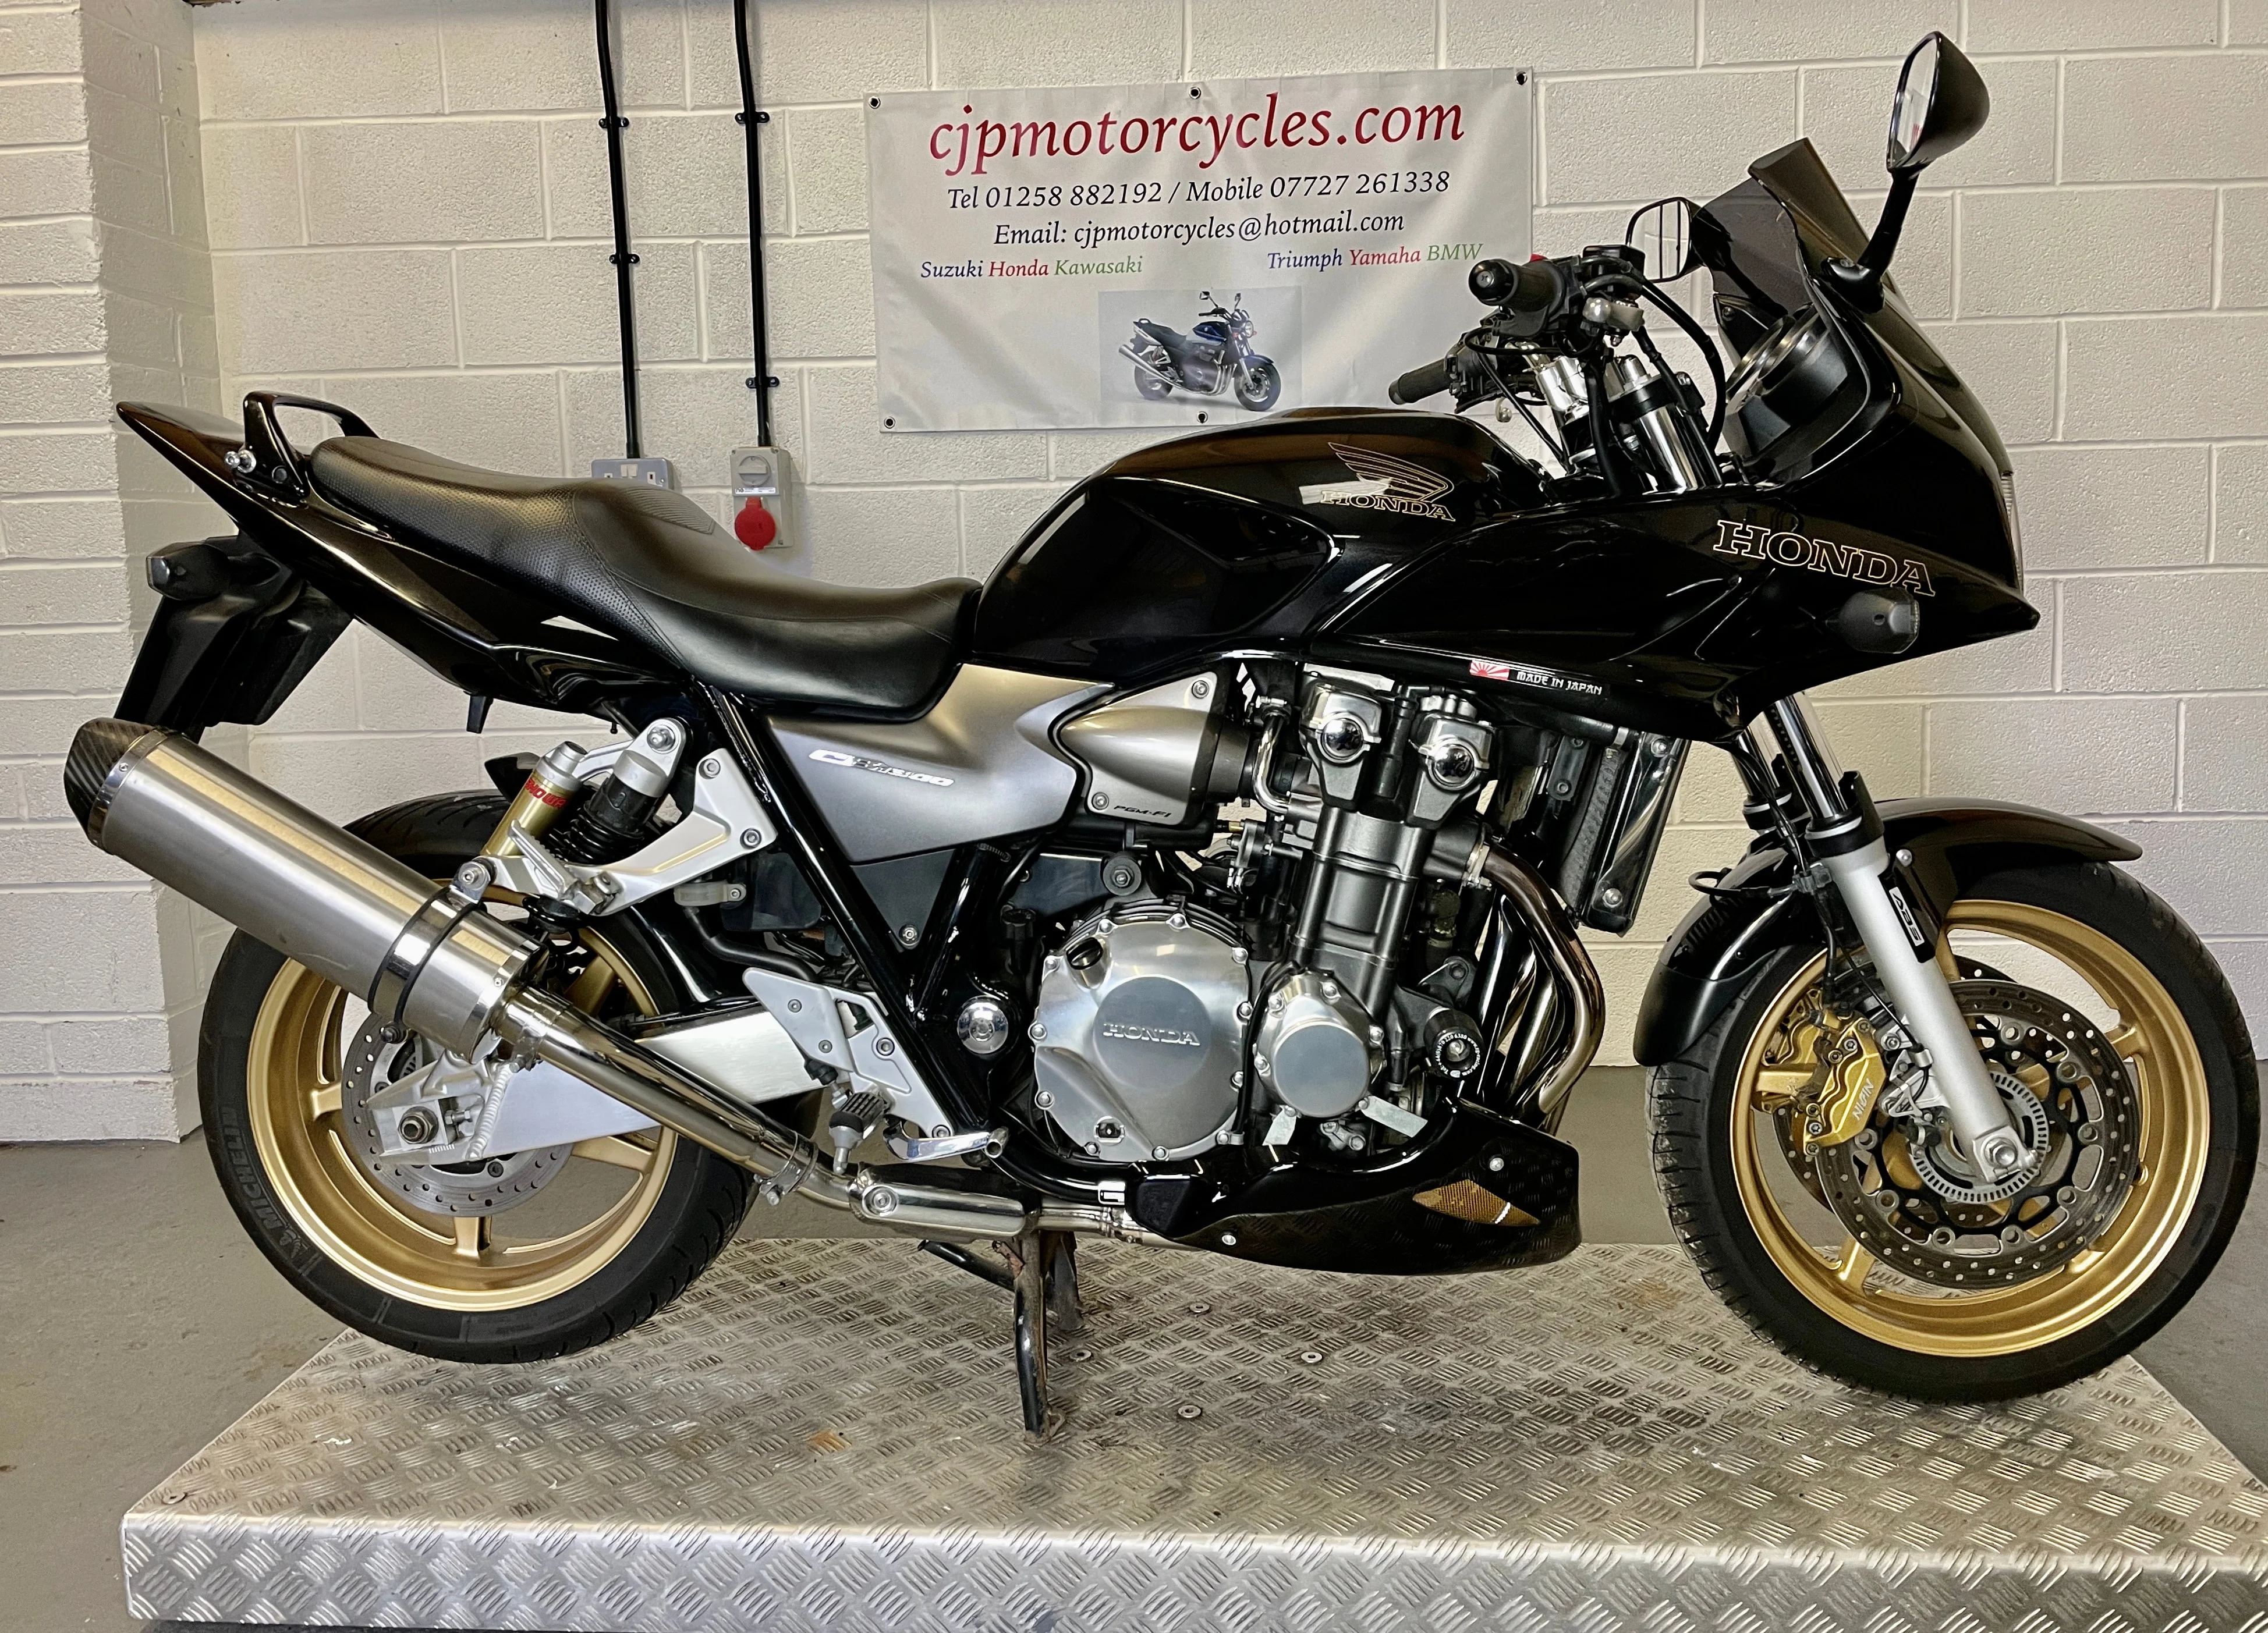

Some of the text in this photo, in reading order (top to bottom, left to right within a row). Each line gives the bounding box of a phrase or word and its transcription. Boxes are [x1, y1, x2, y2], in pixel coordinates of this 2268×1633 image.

[930, 92, 1465, 176] cjpmotorcycles.com
[948, 171, 1451, 209] Tel 01258 882192 / Mobile 07727 261338
[993, 209, 1405, 249] Email: cjpmotorcycles@hotmail.com
[920, 255, 1143, 279] Suzuki Honda Kawasaki
[1267, 243, 1484, 272] Triumph Yamaha BMW
[1320, 491, 1456, 522] HONDA
[1713, 520, 1936, 597] HONDA
[1516, 671, 1603, 695] MADE IN JAPAN
[1892, 892, 1922, 942] ABS
[1103, 1023, 1201, 1046] HONDA
